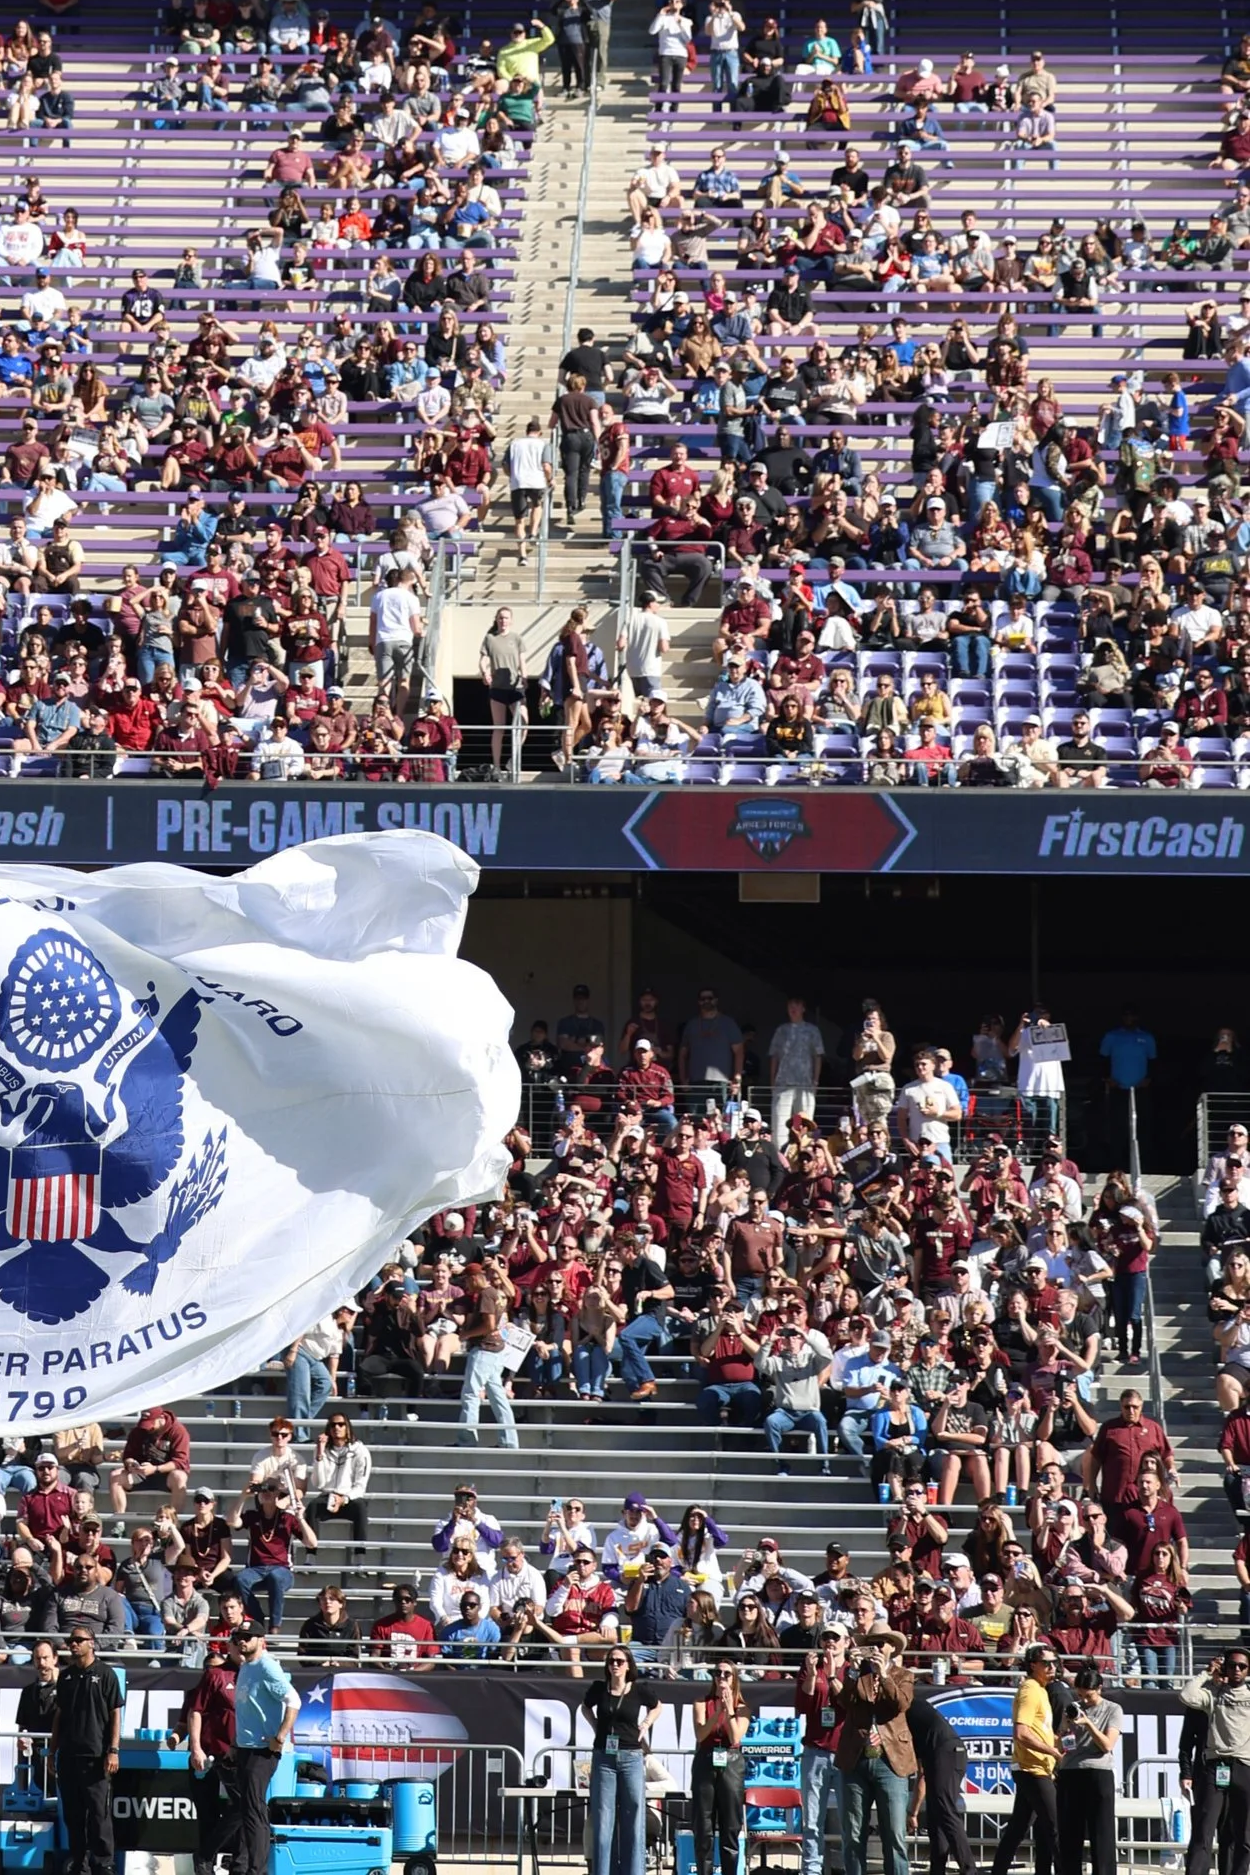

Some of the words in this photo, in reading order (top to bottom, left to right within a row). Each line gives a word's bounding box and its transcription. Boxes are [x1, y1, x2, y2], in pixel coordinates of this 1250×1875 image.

[156, 799, 366, 853] PRE-GAME
[1038, 807, 1244, 859] FirstCash
[103, 1026, 147, 1069] UNUM
[42, 1301, 208, 1376] PARATUS
[945, 1716, 1000, 1727] OCKHEED
[741, 1745, 793, 1754] POWERADE
[974, 1766, 1013, 1780] BOW
[113, 1796, 198, 1820] OWER
